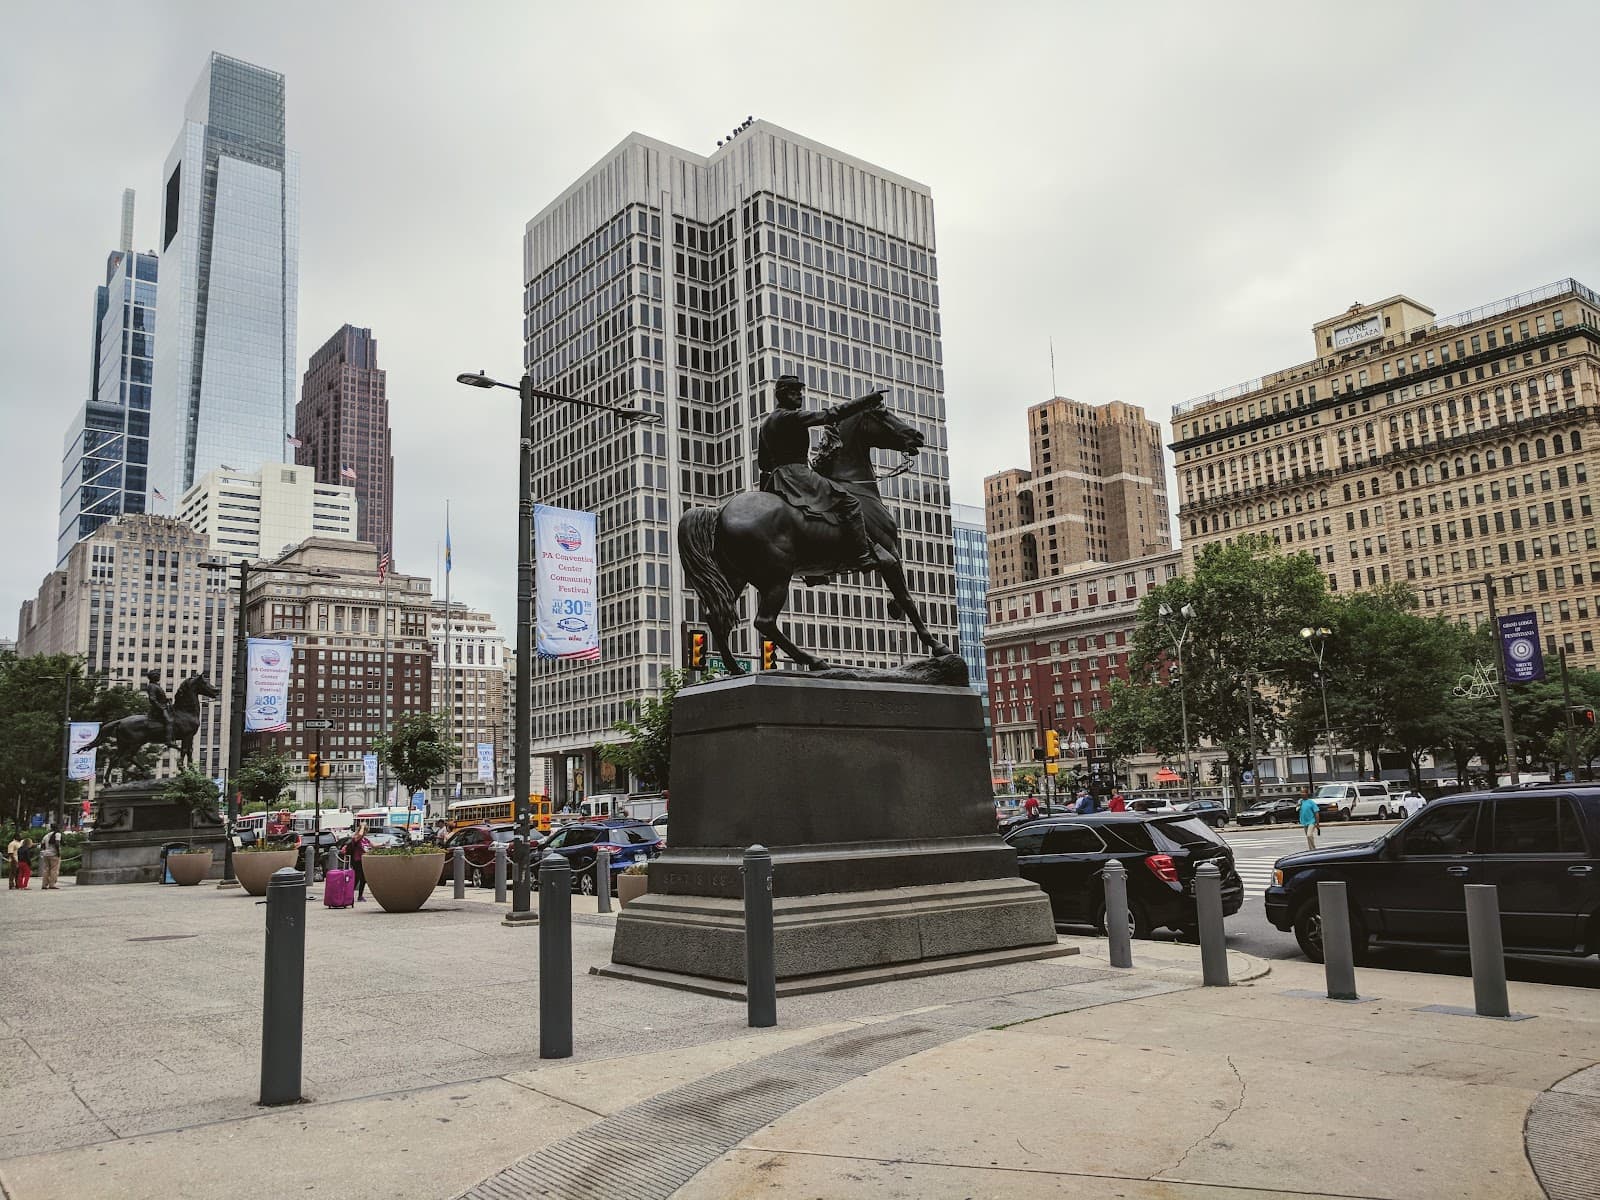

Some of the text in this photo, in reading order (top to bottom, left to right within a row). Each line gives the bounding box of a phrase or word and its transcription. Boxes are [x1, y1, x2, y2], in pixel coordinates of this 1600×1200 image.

[1348, 322, 1367, 335] ONE
[1338, 328, 1379, 345] CITY PLAZA
[555, 553, 593, 563] Convention
[558, 564, 583, 572] Center
[550, 574, 593, 585] Community
[559, 586, 589, 594] Festival
[564, 599, 583, 615] 30
[263, 695, 276, 705] 30
